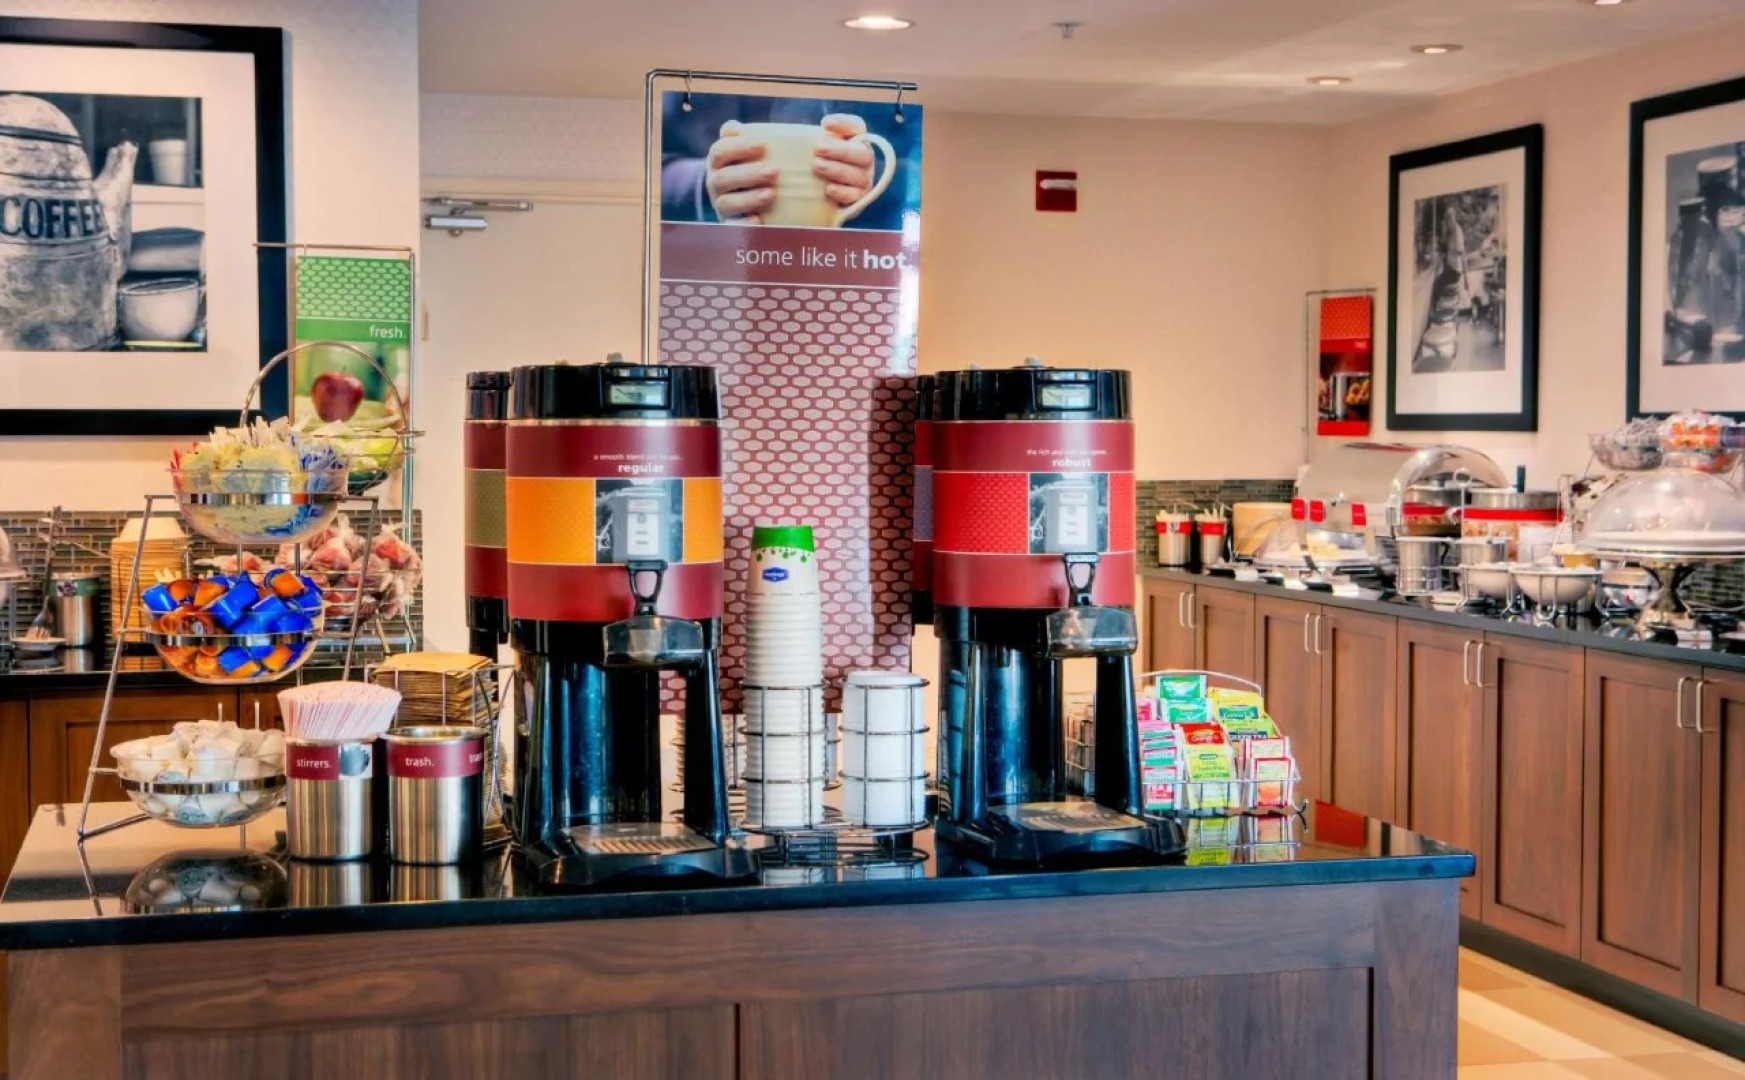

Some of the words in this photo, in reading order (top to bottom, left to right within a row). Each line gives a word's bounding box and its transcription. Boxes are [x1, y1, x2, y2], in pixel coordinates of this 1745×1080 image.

[735, 249, 793, 266] some
[801, 246, 837, 267] like
[844, 249, 857, 268] it
[618, 462, 665, 475] regular
[296, 759, 332, 769] stirrers.
[404, 757, 435, 767] trash.
